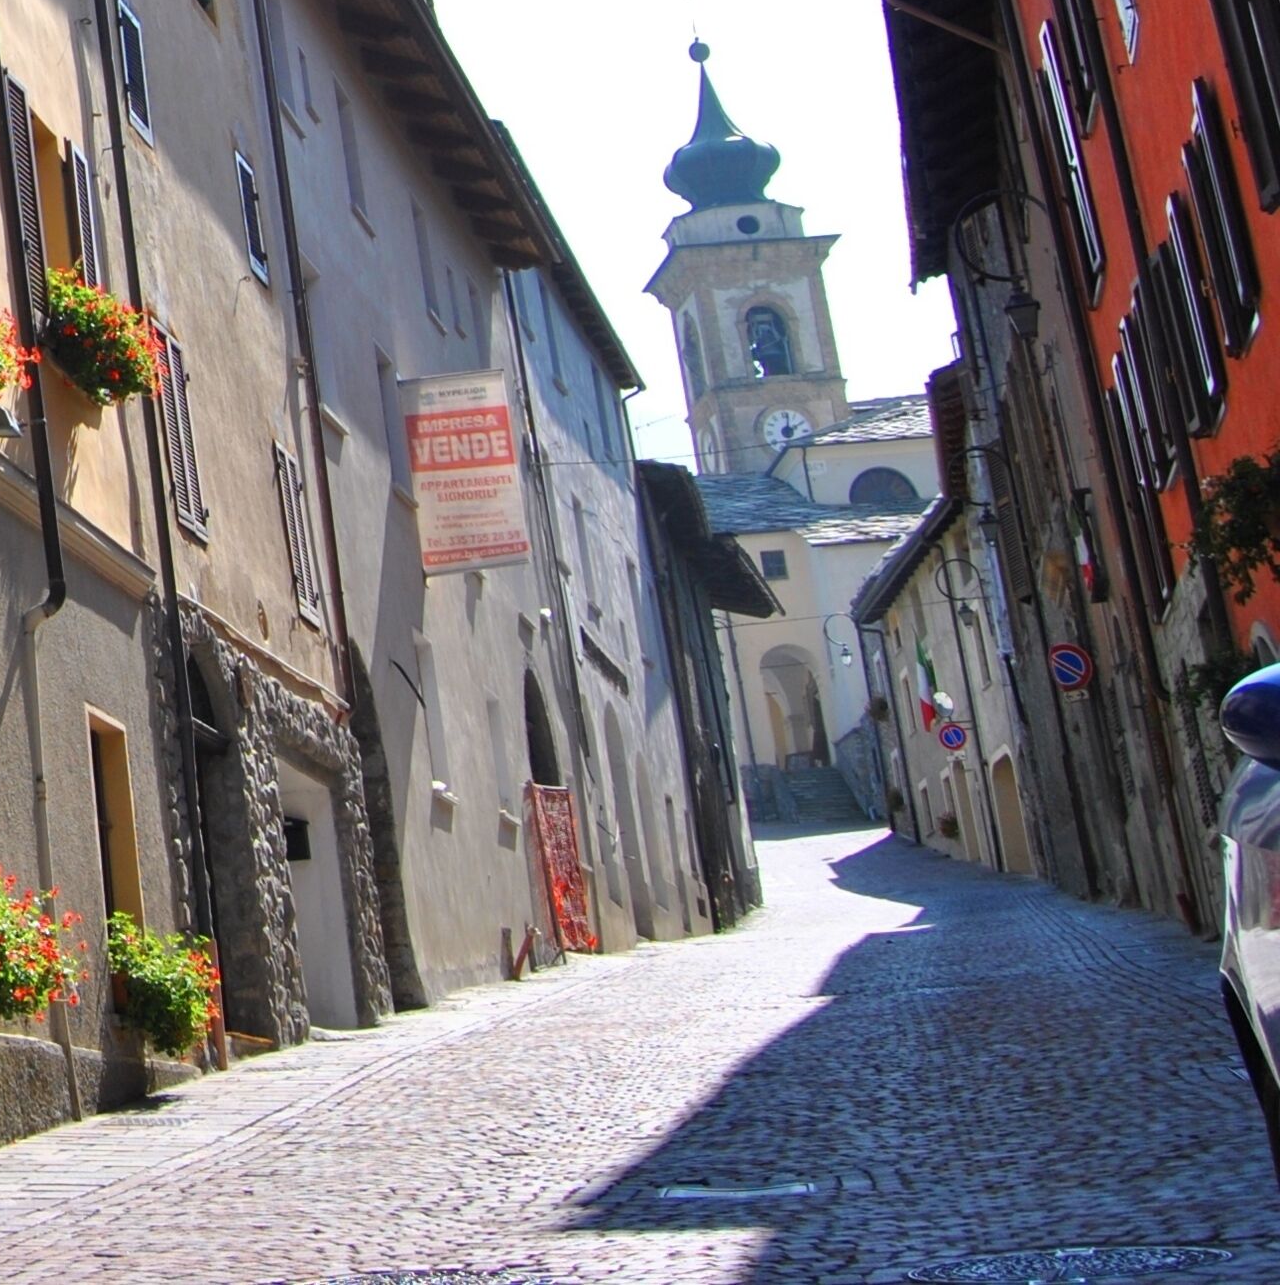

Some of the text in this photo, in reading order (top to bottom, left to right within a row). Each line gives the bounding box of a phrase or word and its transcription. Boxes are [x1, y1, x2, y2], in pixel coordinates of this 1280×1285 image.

[417, 414, 499, 434] IMPRESA
[412, 430, 510, 464] VENDE
[420, 474, 512, 491] APPARTAMENTI
